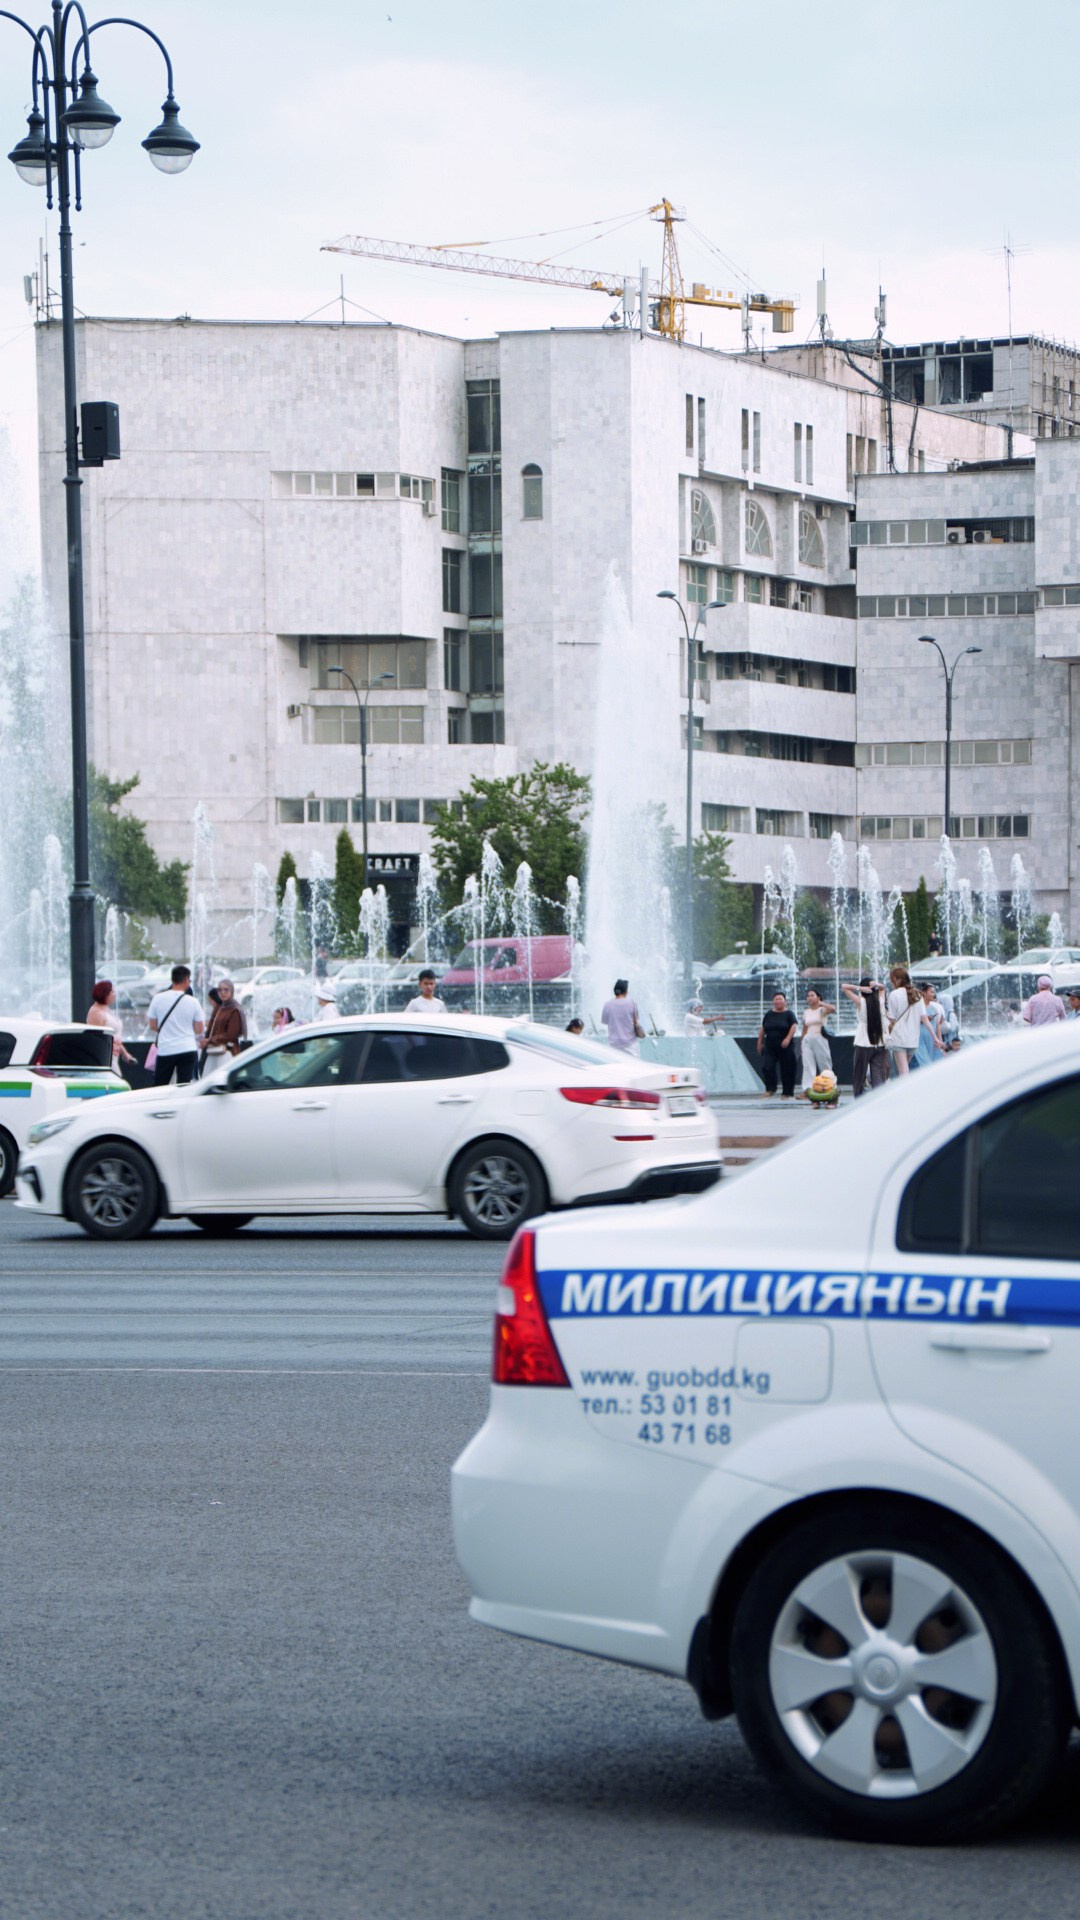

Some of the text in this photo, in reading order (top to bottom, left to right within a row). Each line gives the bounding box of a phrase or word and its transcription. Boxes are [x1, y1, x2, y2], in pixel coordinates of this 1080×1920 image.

[561, 1273, 1012, 1318] МИЛИЦИЯНЫН
[580, 1367, 770, 1395] www. guobdd.kg
[640, 1394, 665, 1416] 53
[673, 1395, 697, 1416] 01
[706, 1396, 732, 1417] 81
[637, 1422, 732, 1446] 43 71 68
